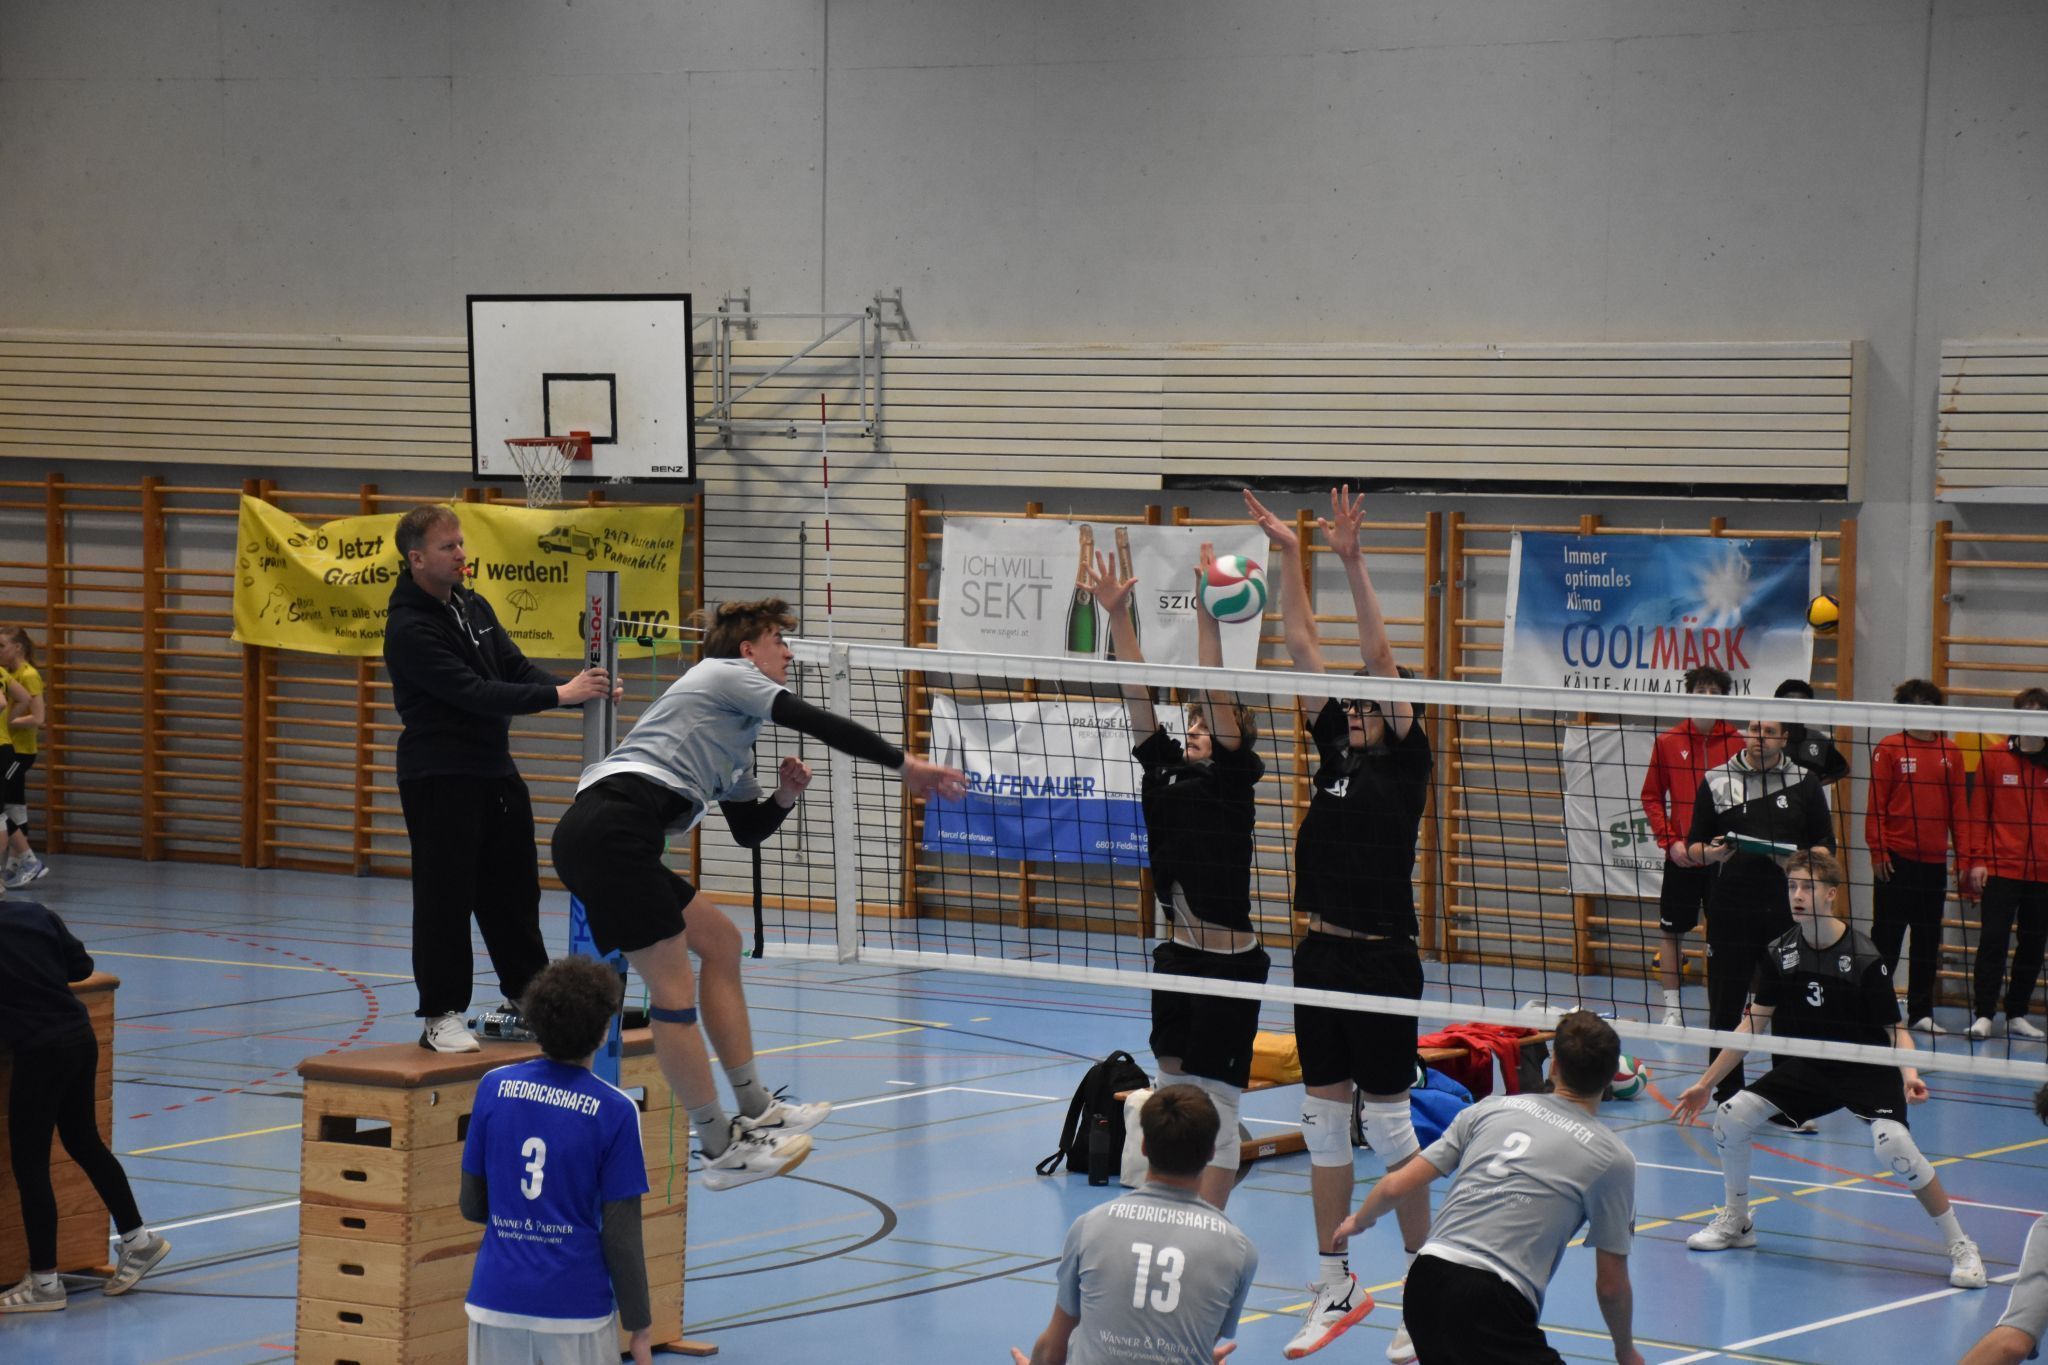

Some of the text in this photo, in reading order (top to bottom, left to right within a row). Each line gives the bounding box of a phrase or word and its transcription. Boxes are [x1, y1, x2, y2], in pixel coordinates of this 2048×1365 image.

[336, 535, 385, 560] Jetzt
[1564, 545, 1607, 565] Immer
[487, 560, 569, 583] werden!
[962, 555, 1053, 580] ICH WILL
[1565, 568, 1631, 589] optimales
[960, 580, 1053, 621] SEKT
[1566, 592, 1602, 612] Klima
[329, 606, 389, 619] Für alle vo
[335, 626, 386, 640] Keine Kost
[1562, 615, 1751, 672] COOLMÄRK
[1072, 714, 1118, 729] PRÄZISE
[937, 830, 959, 839] Marcel
[1095, 840, 1115, 849] 6800
[1806, 981, 1825, 1007] 3
[497, 1080, 601, 1116] FRIEDRICHSHAFEN
[1486, 1131, 1532, 1178] 2
[520, 1136, 547, 1200] 3
[524, 1218, 533, 1231] &
[535, 1220, 574, 1234] PARTNER
[1108, 1203, 1227, 1235] FRIEDRICHSHAFEN
[1131, 1242, 1185, 1313] 13
[1100, 1330, 1141, 1347] WANNER
[1143, 1335, 1153, 1349] &
